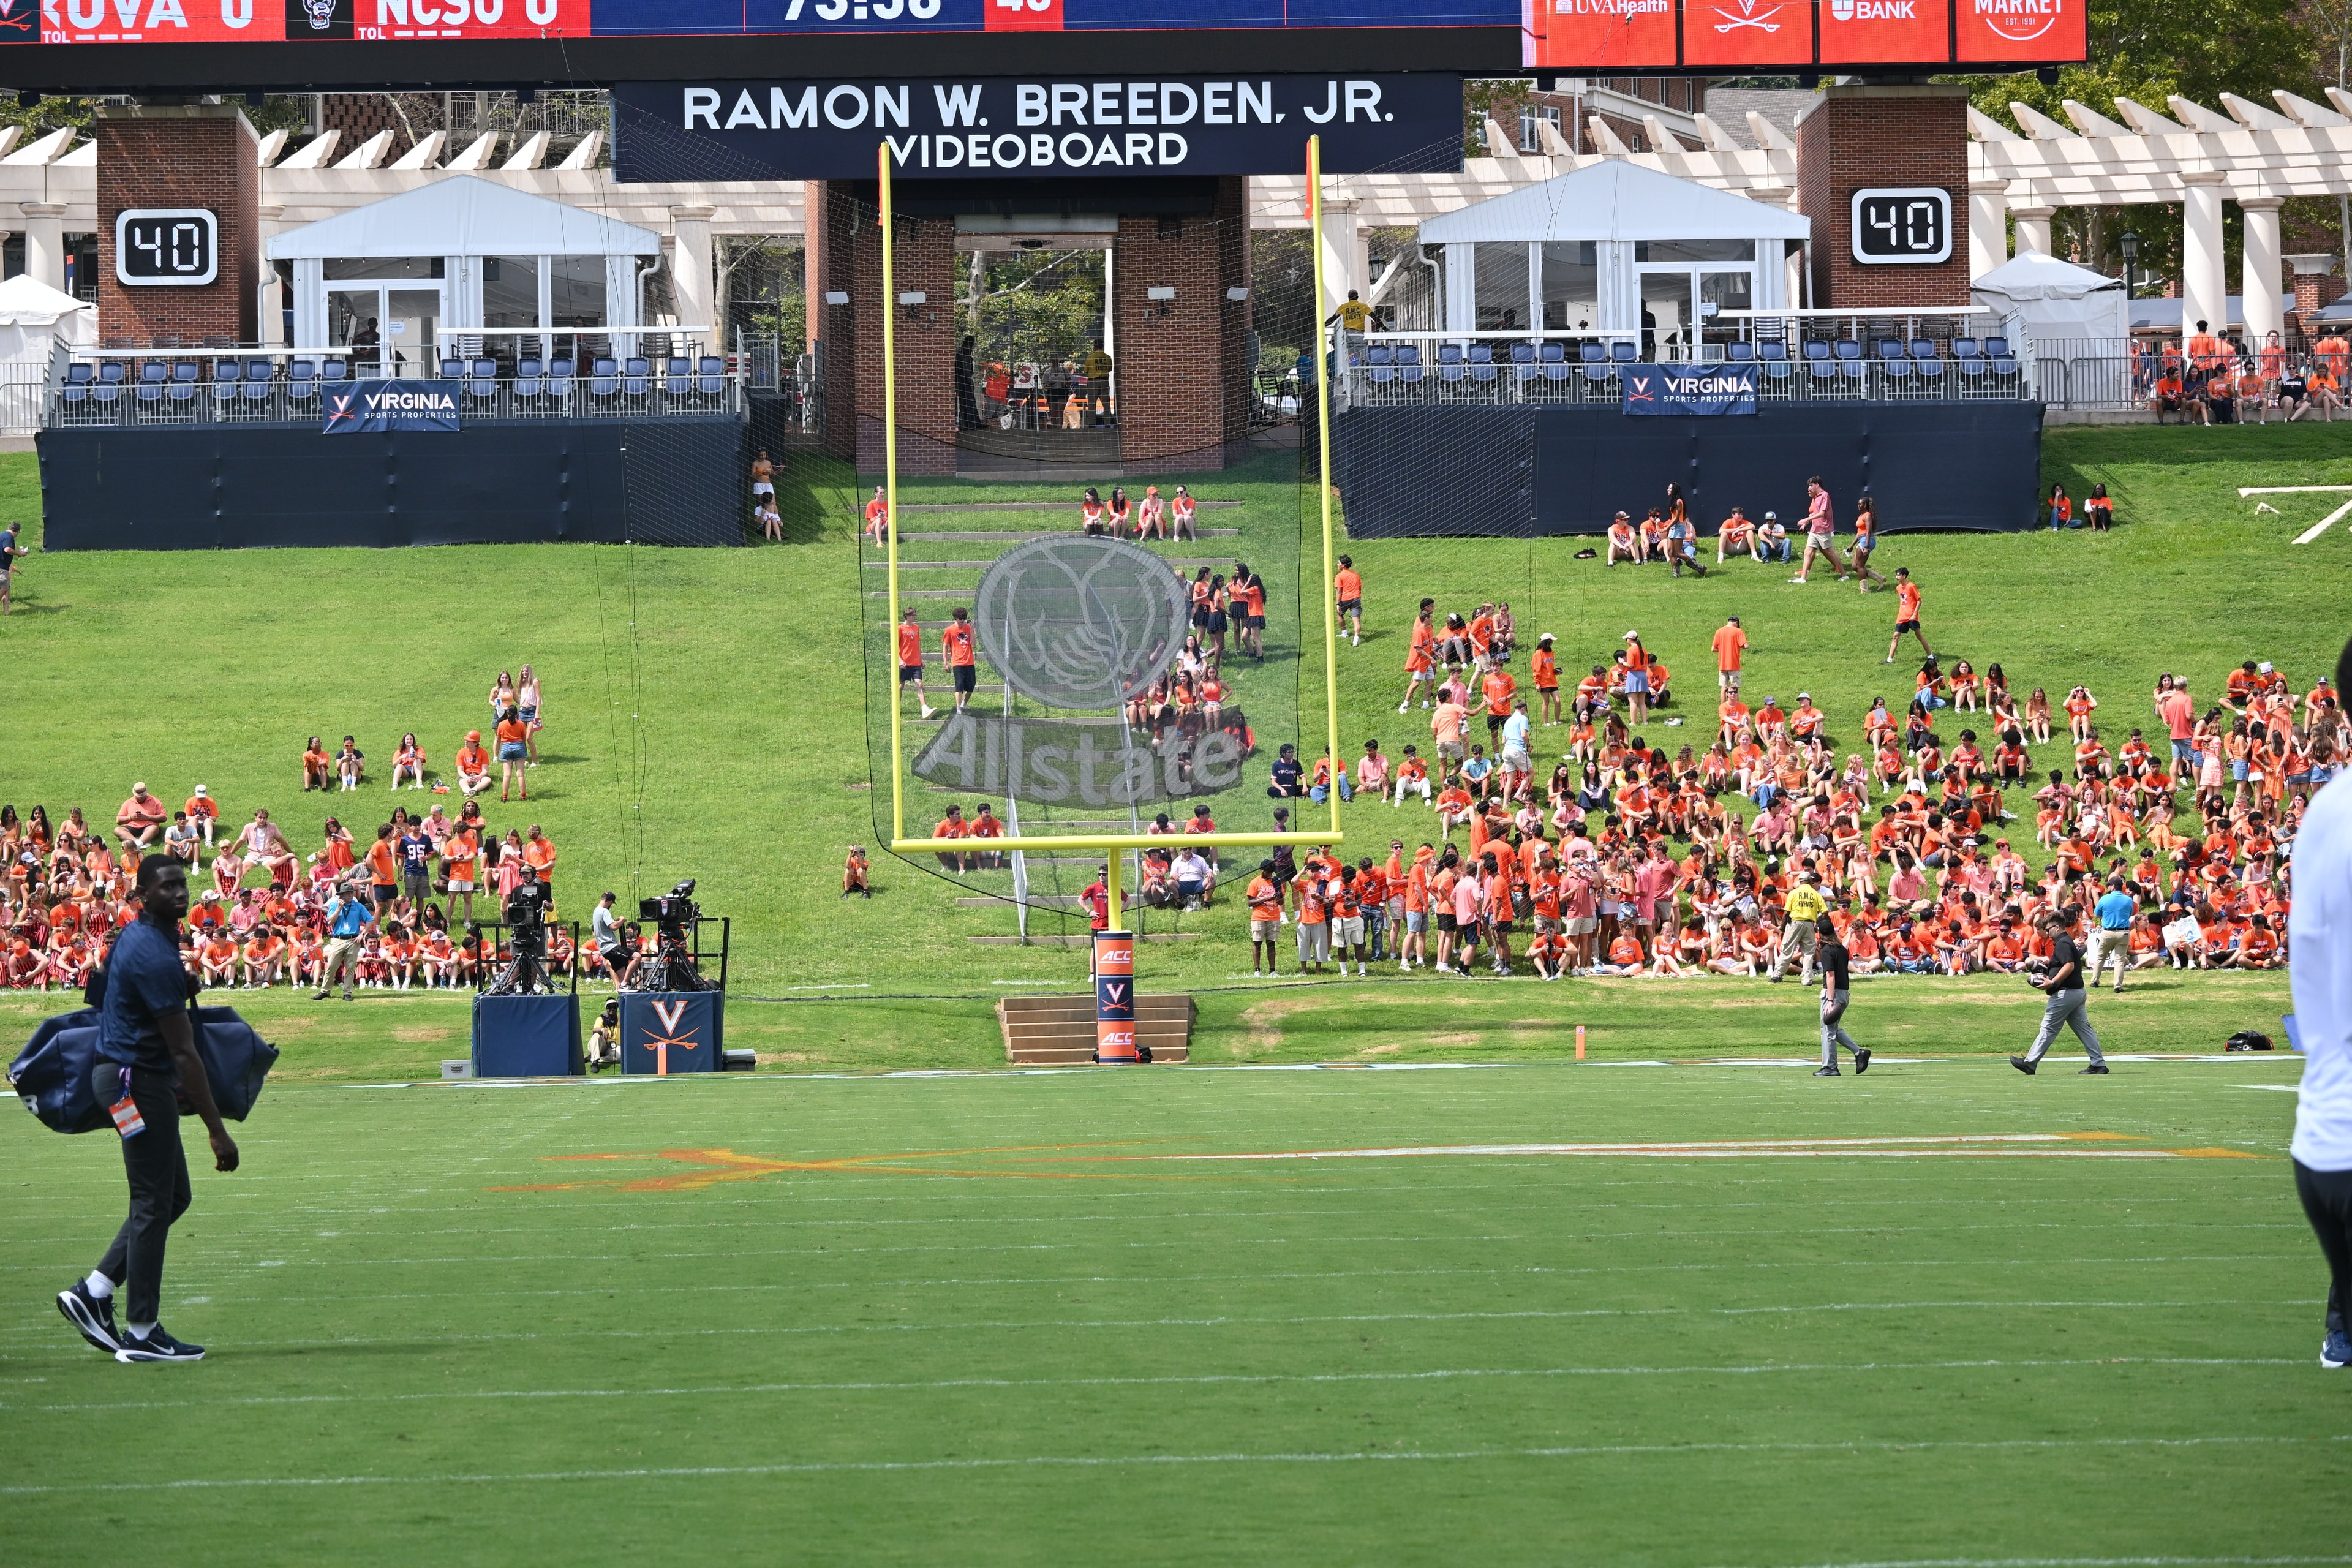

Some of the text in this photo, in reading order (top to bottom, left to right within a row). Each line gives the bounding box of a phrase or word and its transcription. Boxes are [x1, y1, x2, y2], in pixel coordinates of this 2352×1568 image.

[1856, 1, 1916, 19] BANK
[1975, 0, 2062, 14] MARKET
[42, 31, 70, 43] TOL
[358, 27, 386, 40] TOL
[684, 85, 909, 130] RAMON
[934, 85, 988, 127] W.
[1303, 80, 1395, 124] JR.
[886, 132, 1188, 169] VIDEOBOARD
[1870, 202, 1934, 249] 40
[134, 223, 200, 271] 40
[1664, 377, 1754, 394] VIRGINIA
[364, 393, 455, 410] VIRGINIA
[1700, 394, 1755, 403] PROPERTIES
[915, 712, 1239, 805] Allstate
[407, 844, 426, 860] 95
[1798, 892, 1815, 901] R.M.C.
[1099, 950, 1131, 961] ACC
[1101, 1032, 1133, 1042] ACC
